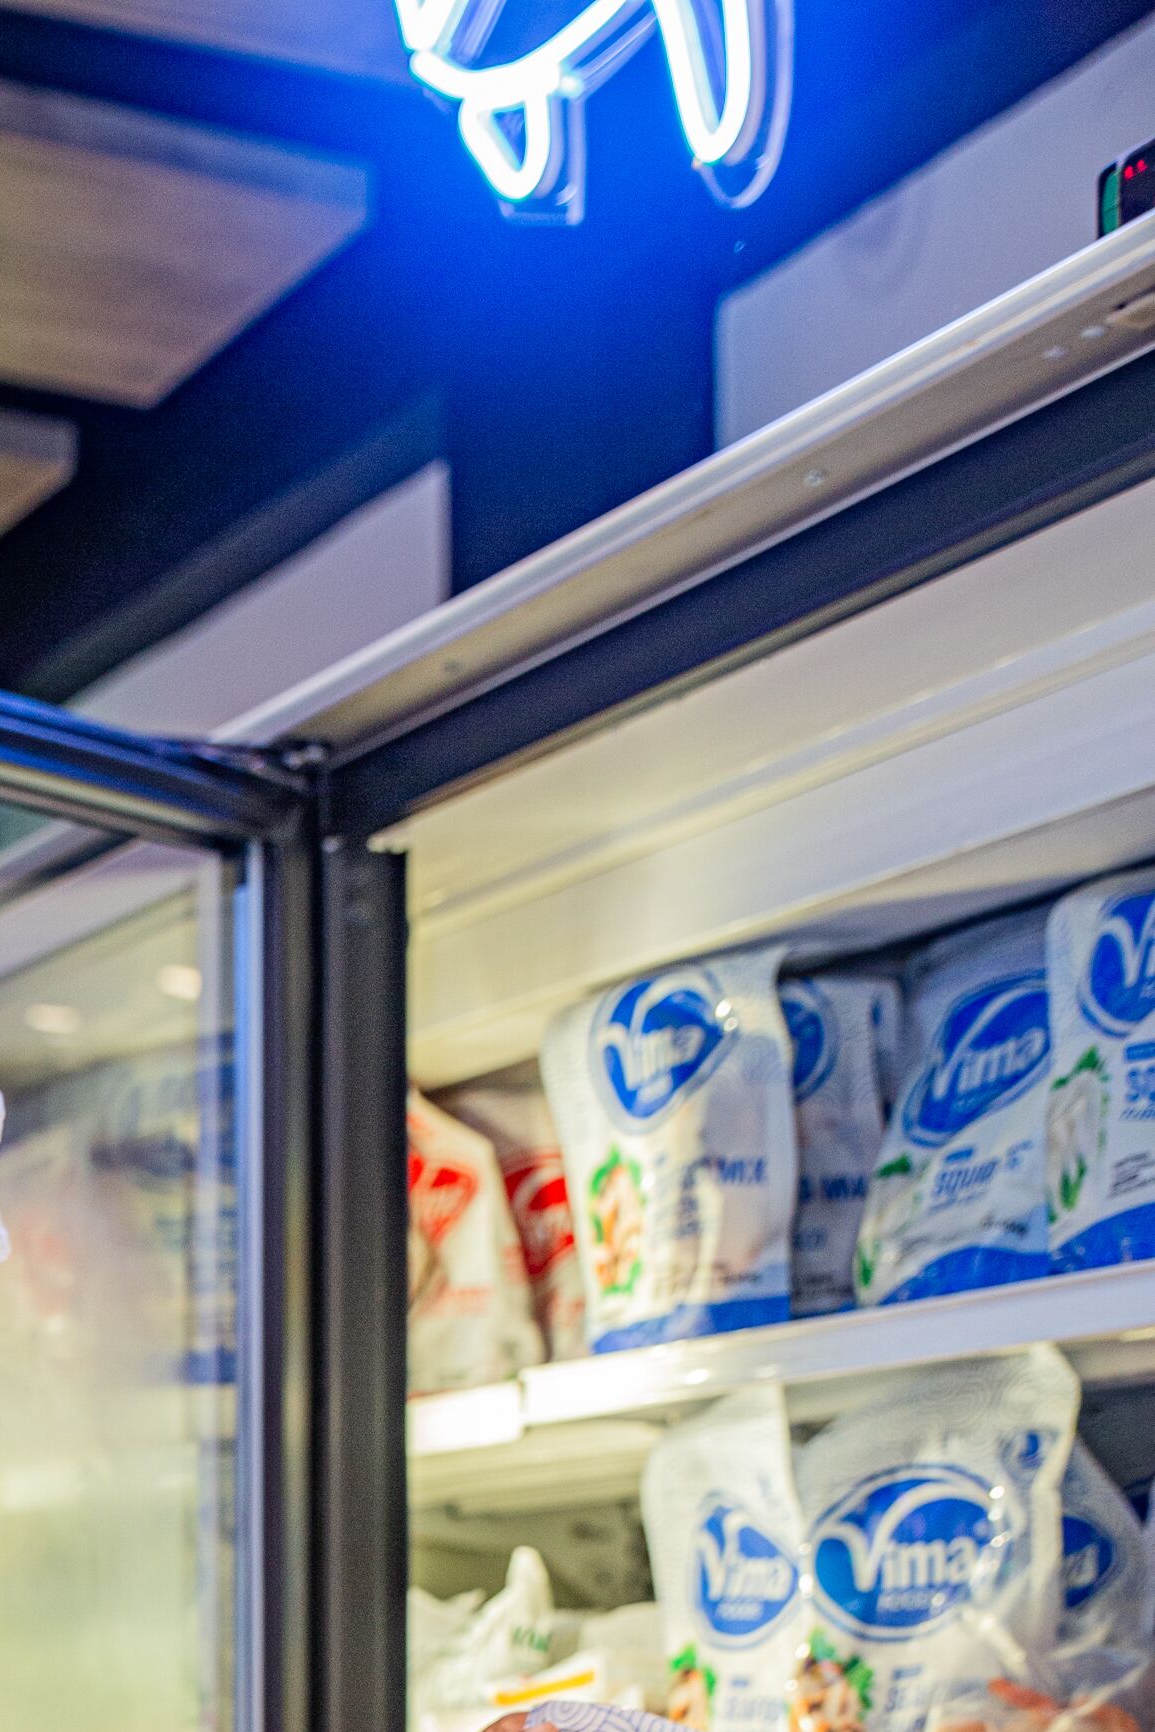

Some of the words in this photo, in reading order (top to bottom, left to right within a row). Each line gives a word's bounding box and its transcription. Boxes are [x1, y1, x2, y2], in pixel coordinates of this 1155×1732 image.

[931, 1015, 1046, 1098] Vima
[699, 1518, 793, 1601] Vima
[824, 1512, 977, 1592] Vima
